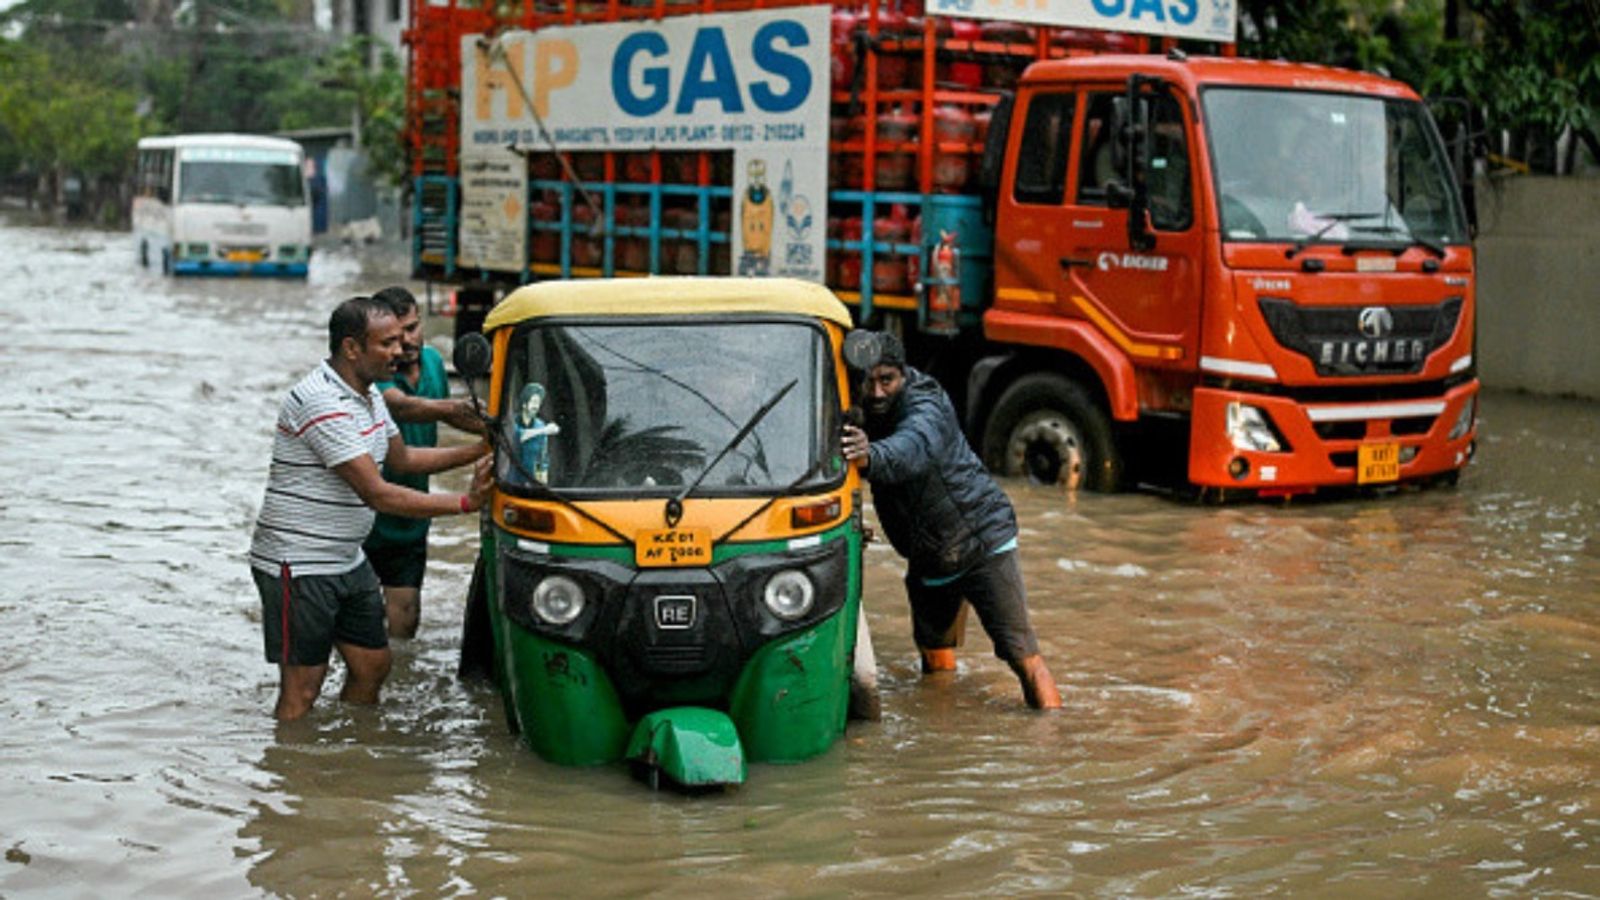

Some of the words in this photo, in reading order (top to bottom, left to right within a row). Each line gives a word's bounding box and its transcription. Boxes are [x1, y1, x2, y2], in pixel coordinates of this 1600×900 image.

[474, 38, 580, 121] HP
[611, 20, 812, 117] GAS
[1122, 254, 1168, 270] EICHER
[1320, 340, 1424, 364] EICHER
[662, 606, 689, 622] RE
